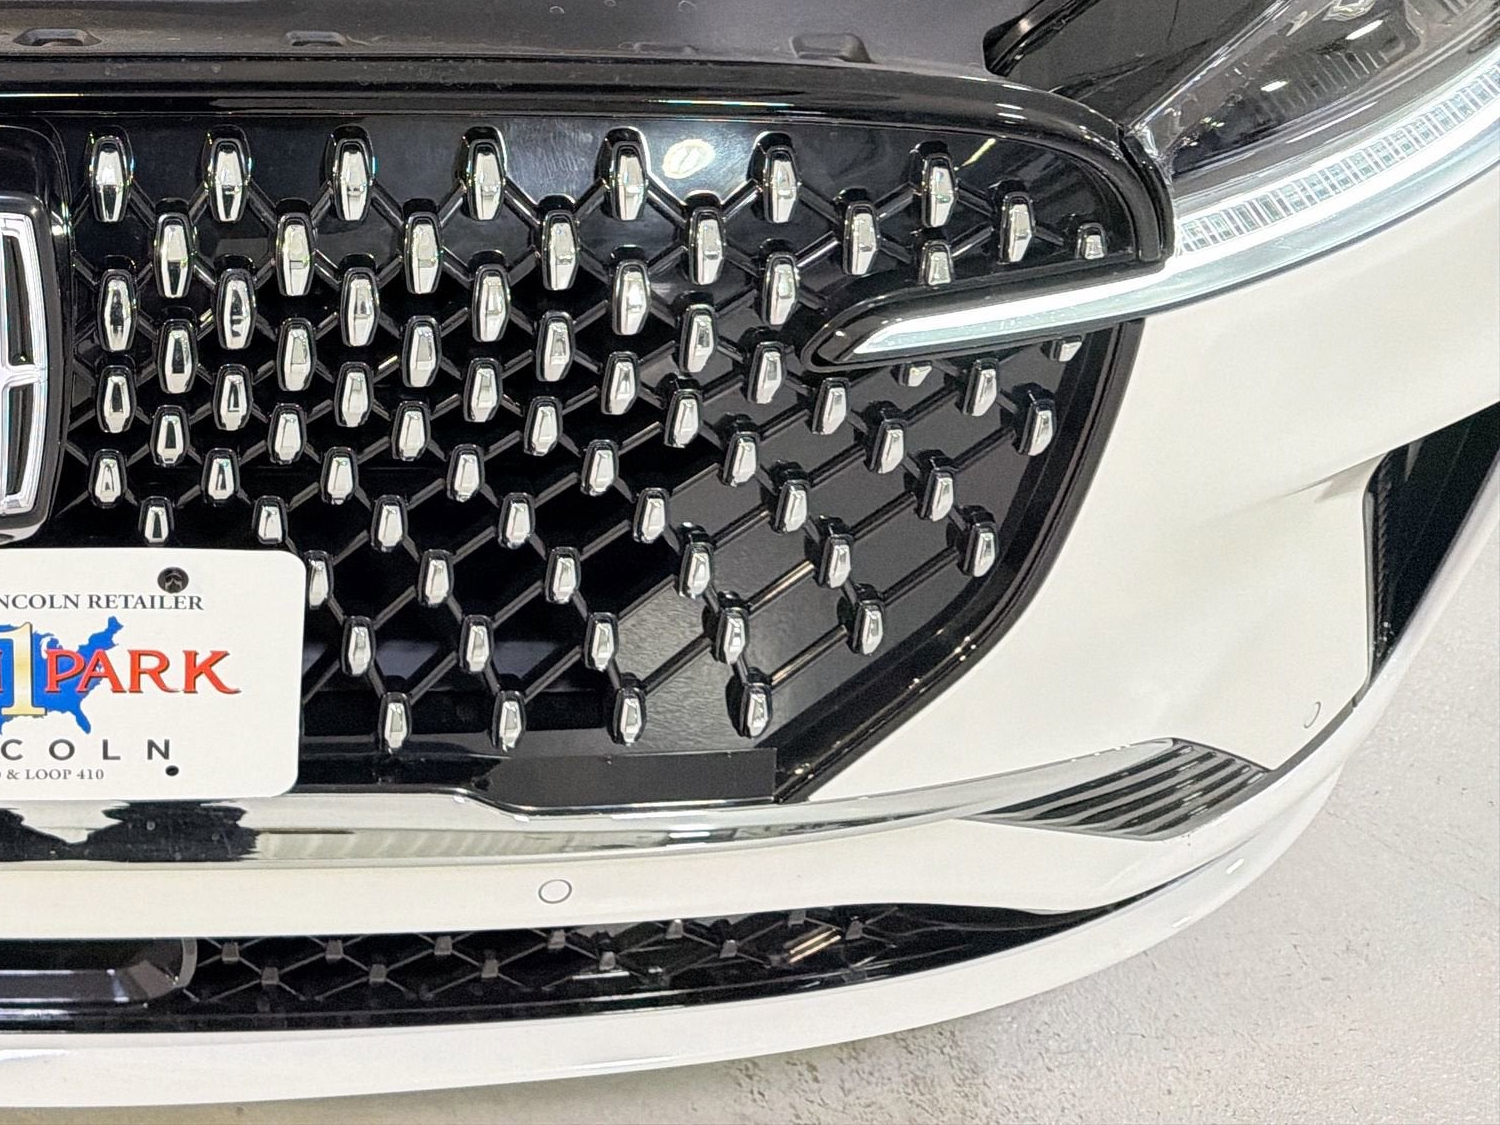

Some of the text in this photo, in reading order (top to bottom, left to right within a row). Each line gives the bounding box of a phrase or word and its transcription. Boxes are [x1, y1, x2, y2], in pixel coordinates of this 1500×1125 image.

[88, 594, 204, 611] RETAILER
[45, 648, 241, 697] PARK
[7, 768, 19, 781] &
[25, 768, 72, 781] LOOP
[76, 768, 105, 781] 410
